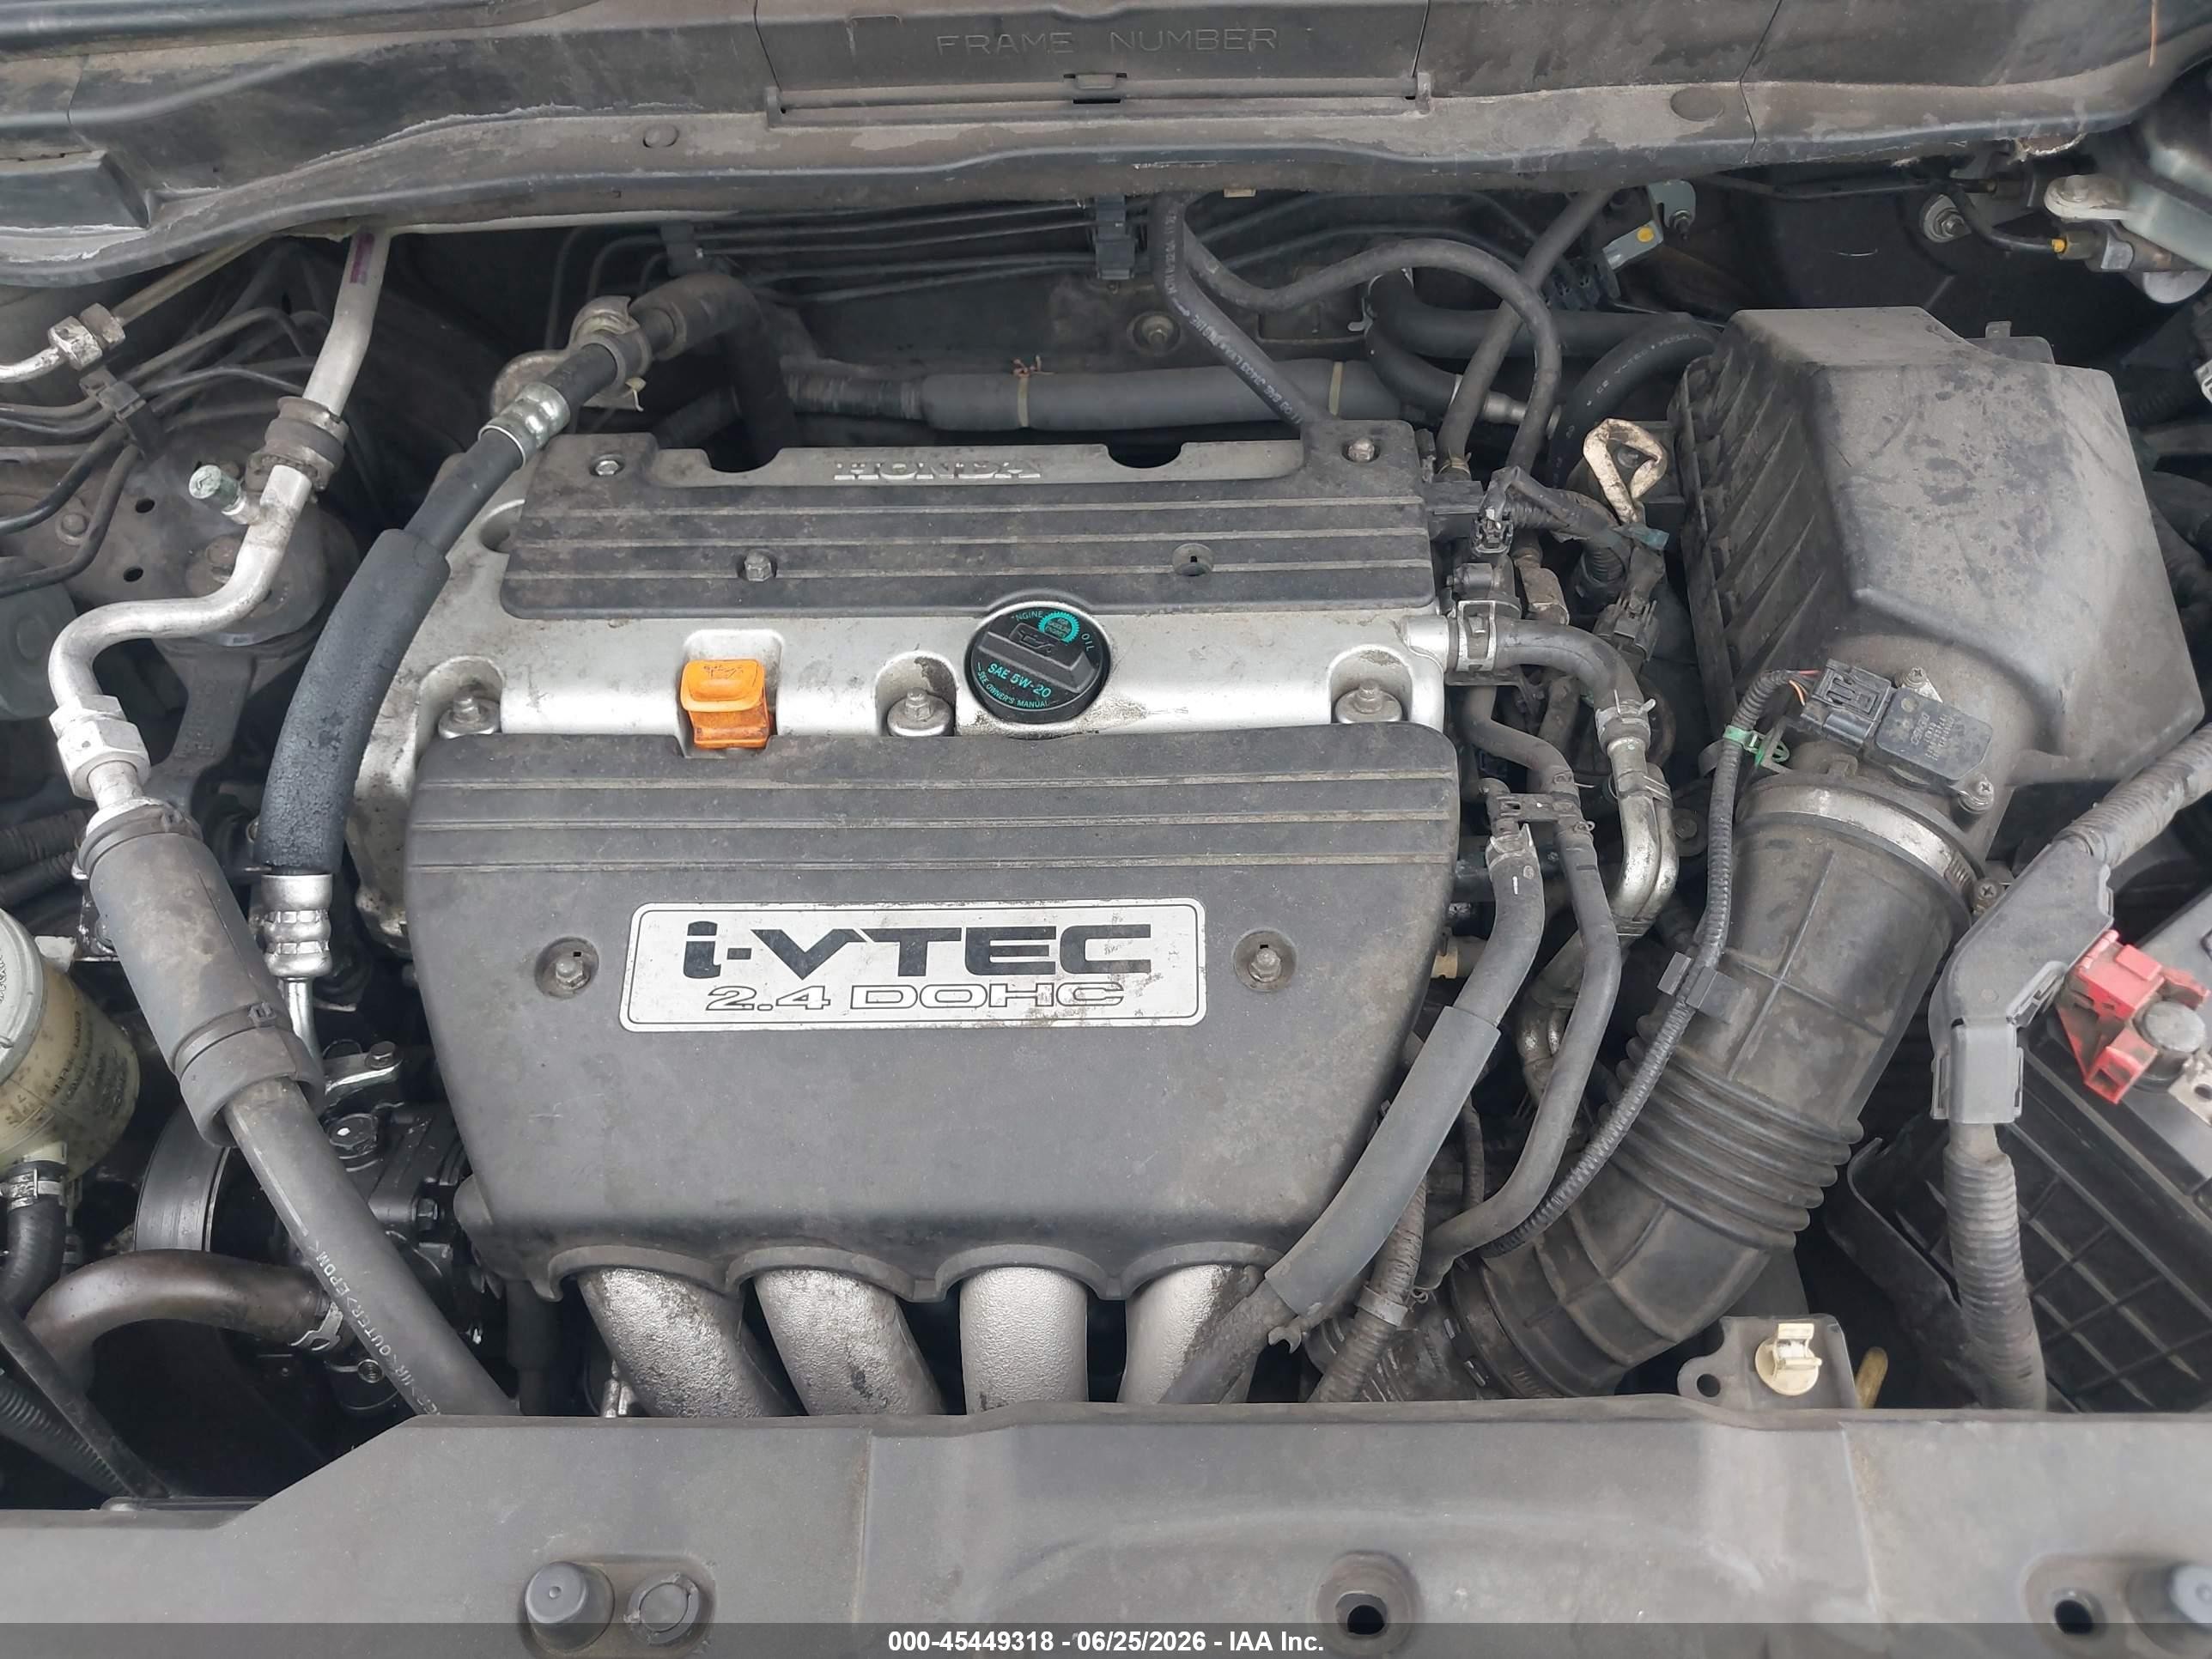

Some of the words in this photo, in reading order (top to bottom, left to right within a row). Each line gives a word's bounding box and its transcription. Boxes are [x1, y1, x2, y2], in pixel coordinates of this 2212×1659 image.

[936, 32, 1075, 55] FRAME
[1109, 27, 1278, 52] NUMBER
[834, 462, 1042, 481] HONDA
[1081, 633, 1095, 652] OIL
[988, 663, 1011, 680] SAE
[1010, 674, 1052, 698] 5W-20
[986, 684, 1015, 704] OWNER'S
[1017, 700, 1049, 708] MANUAL
[683, 921, 1152, 980] i-VTEC
[706, 985, 831, 1012] 2.4
[850, 981, 1124, 1010] DOHC
